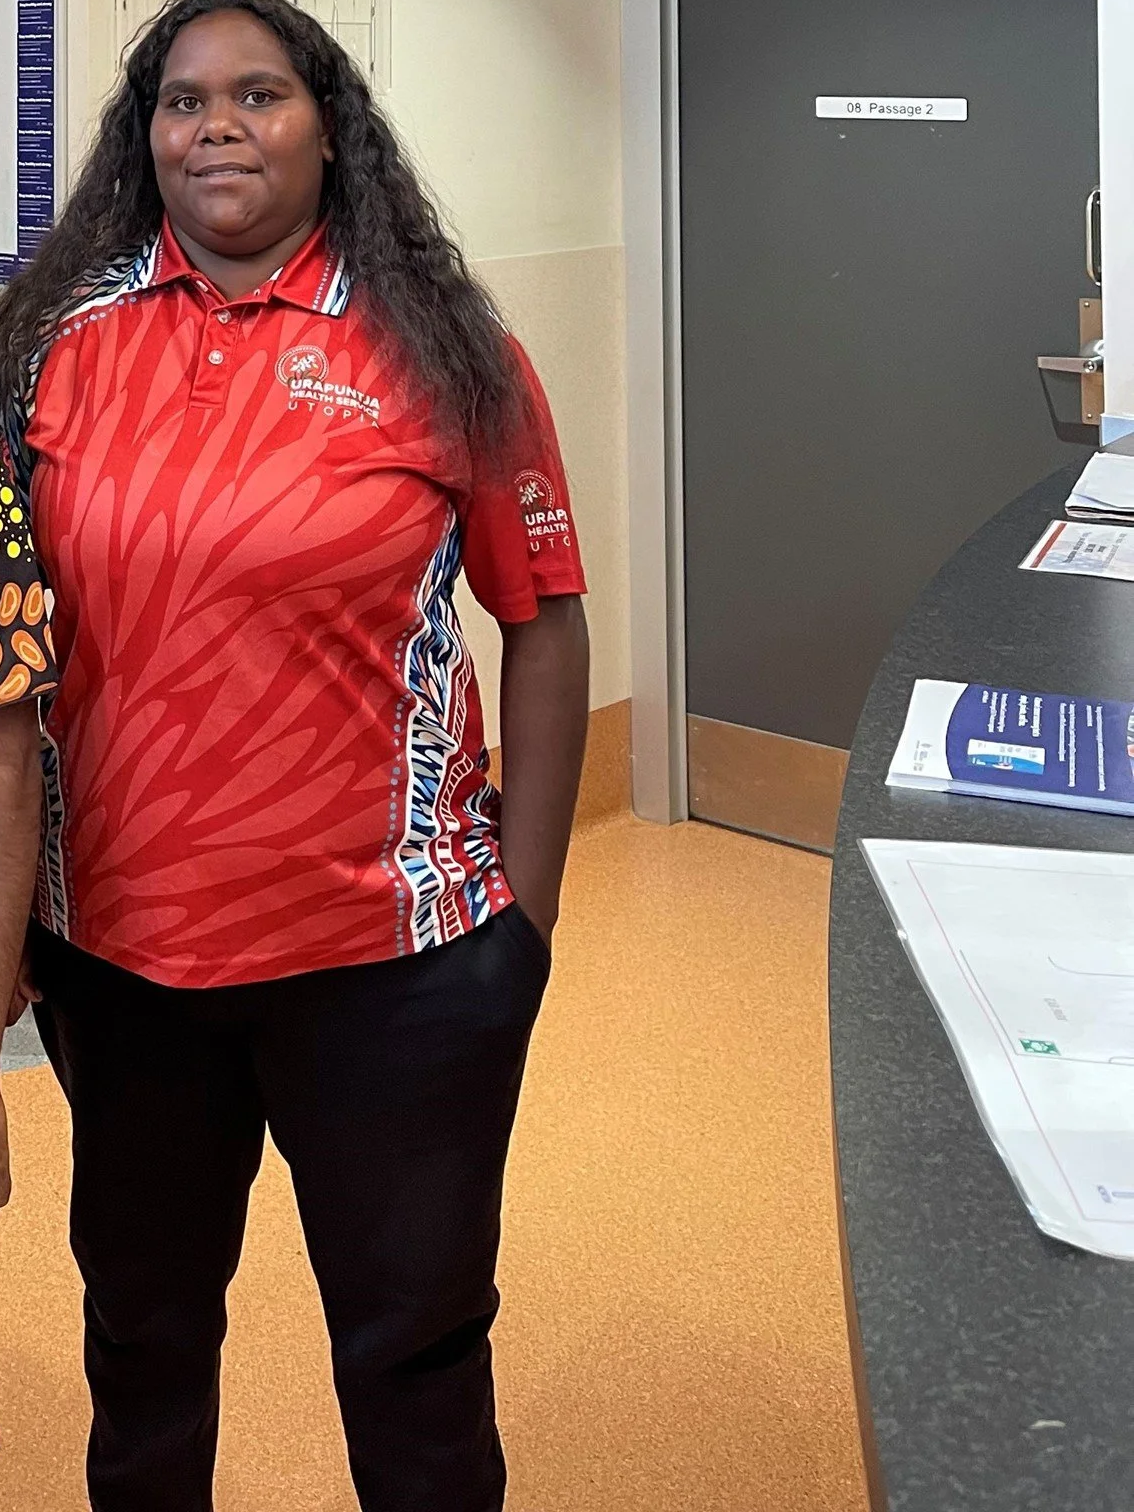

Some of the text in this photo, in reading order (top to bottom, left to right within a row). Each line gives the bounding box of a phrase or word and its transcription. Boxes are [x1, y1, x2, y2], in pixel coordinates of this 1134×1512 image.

[846, 102, 934, 117] 08 Passage 2
[289, 390, 379, 419] HEALTH SERVICE
[290, 378, 381, 409] URAPUNTJA
[525, 508, 569, 526] URAP
